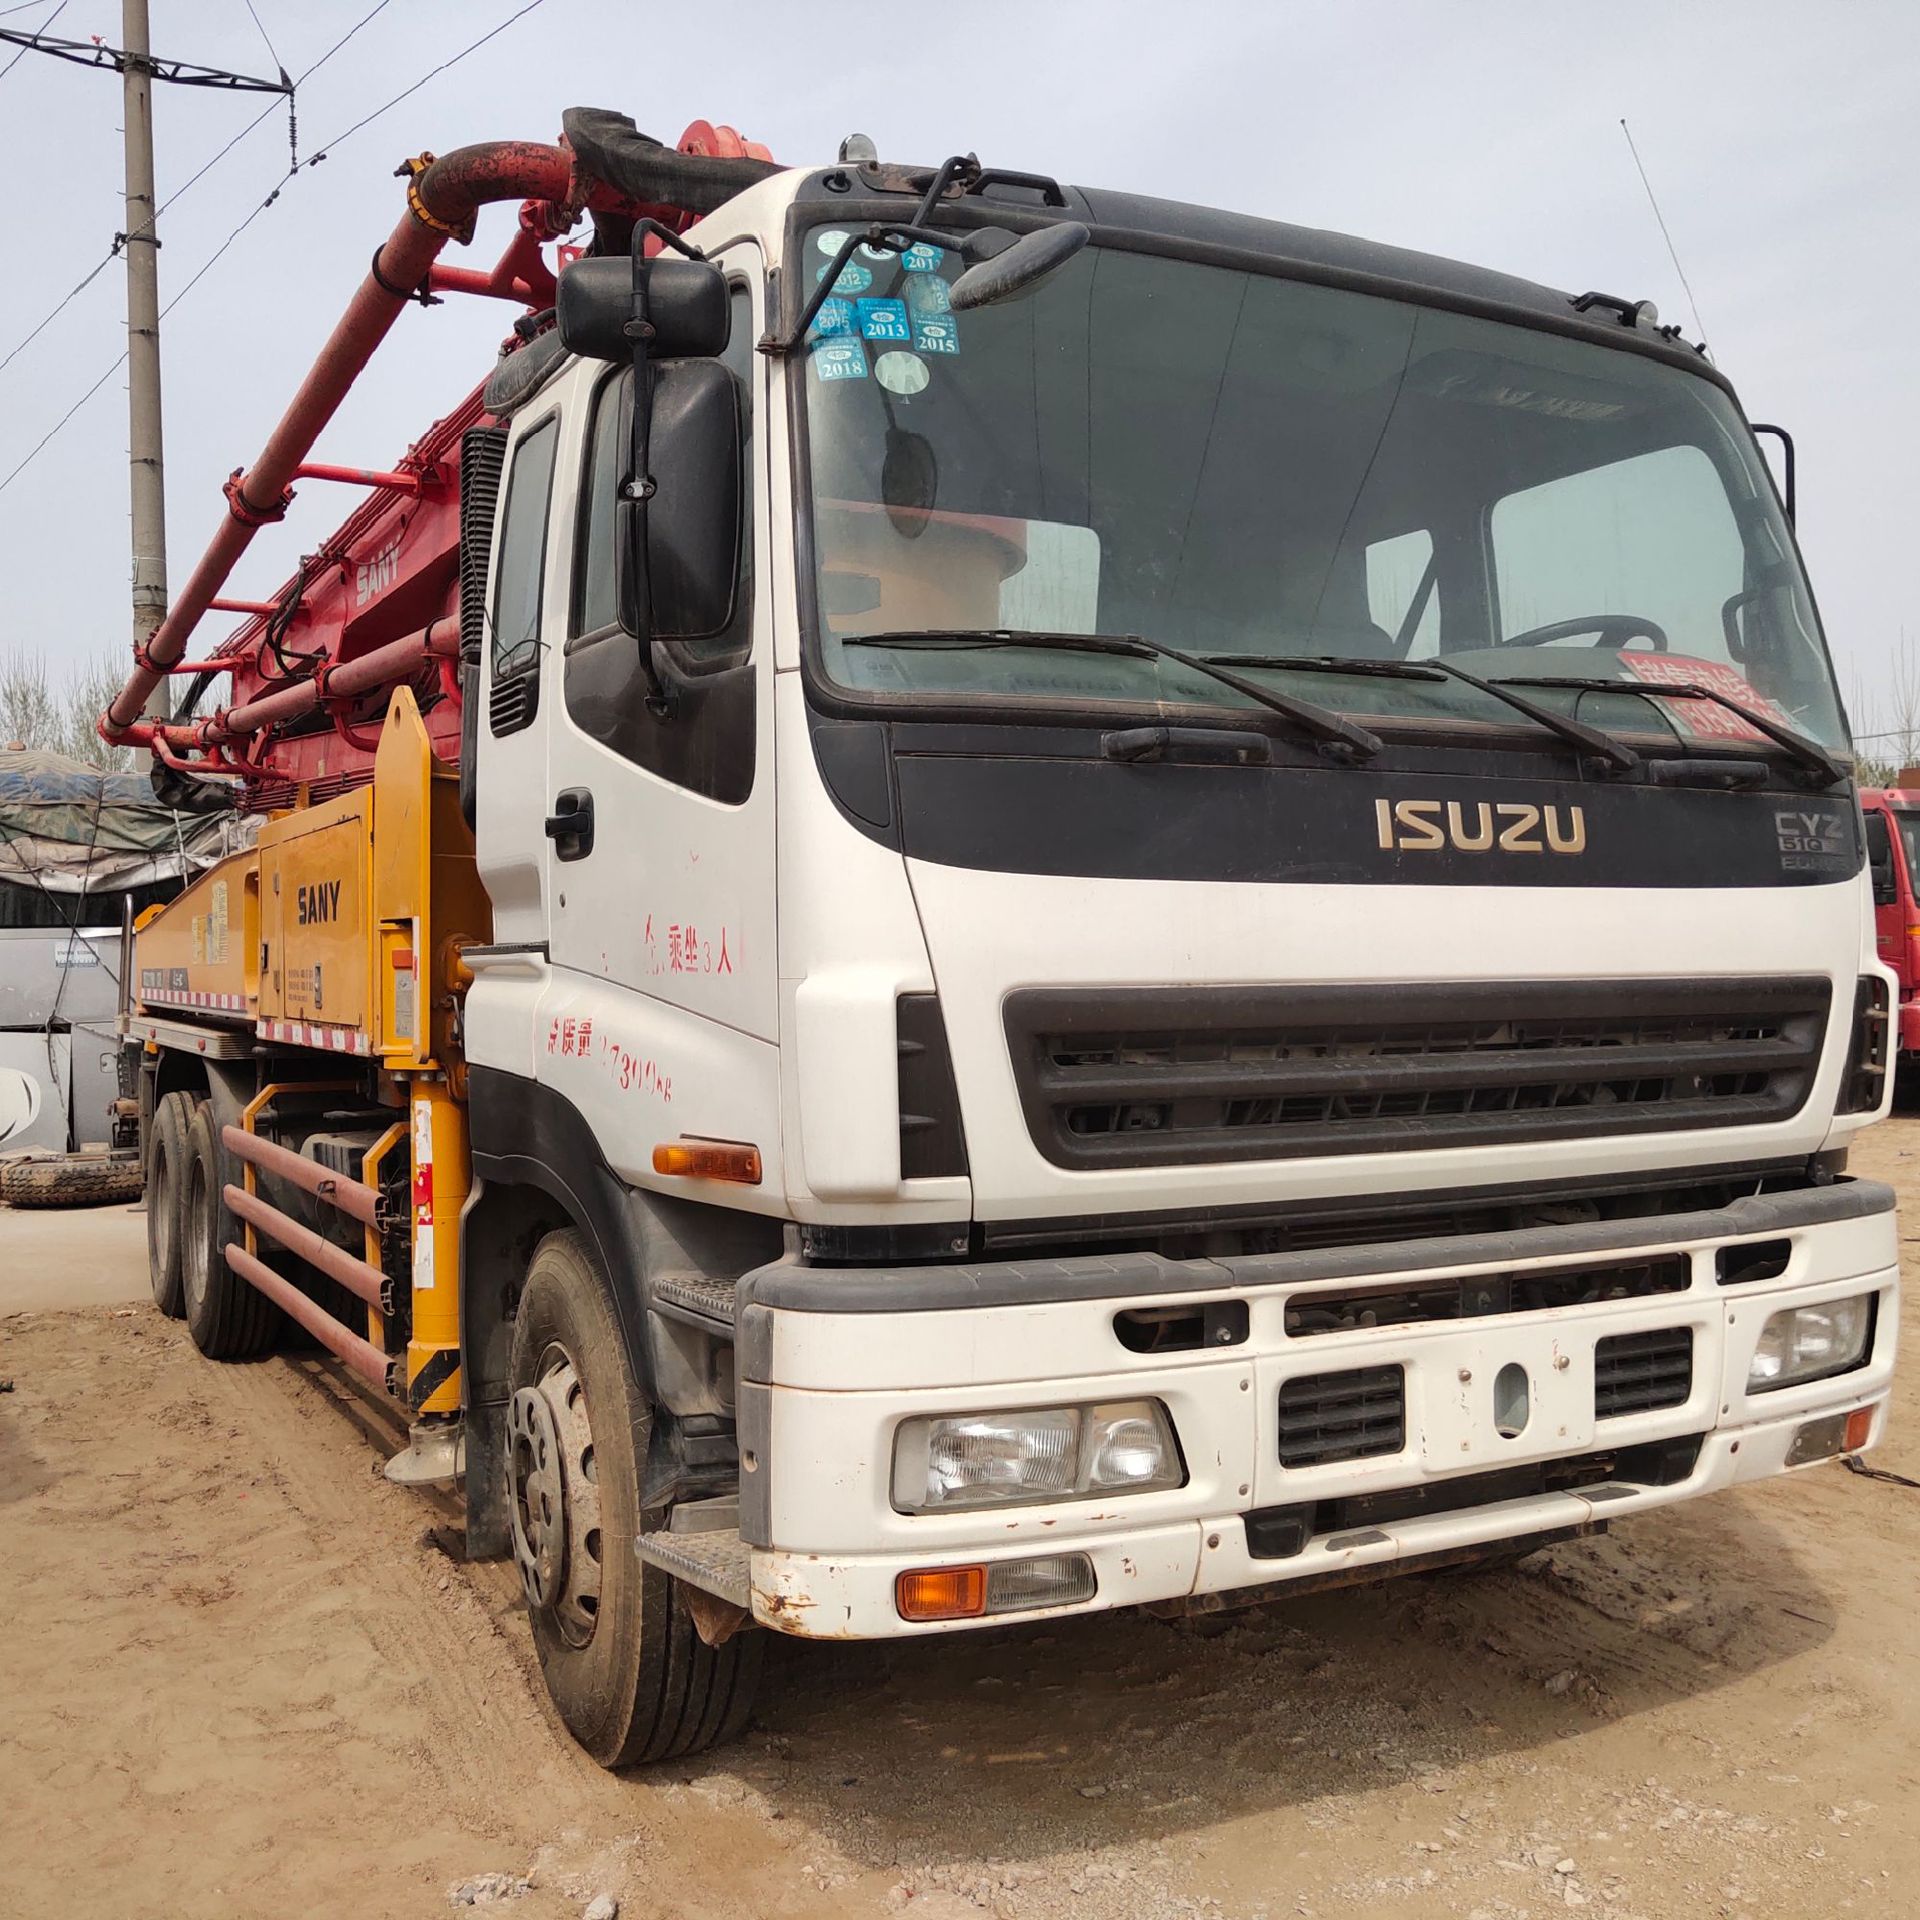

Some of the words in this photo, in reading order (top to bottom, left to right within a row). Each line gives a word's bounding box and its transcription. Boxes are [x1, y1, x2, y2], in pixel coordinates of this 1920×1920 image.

[867, 323, 905, 337] 2013
[919, 336, 955, 352] 2015
[822, 361, 863, 377] 2018
[355, 534, 402, 608] SANY
[1375, 798, 1586, 853] ISUZU
[1774, 811, 1844, 838] CYZ
[298, 879, 341, 925] SANY
[645, 914, 732, 975] 乘坐3人
